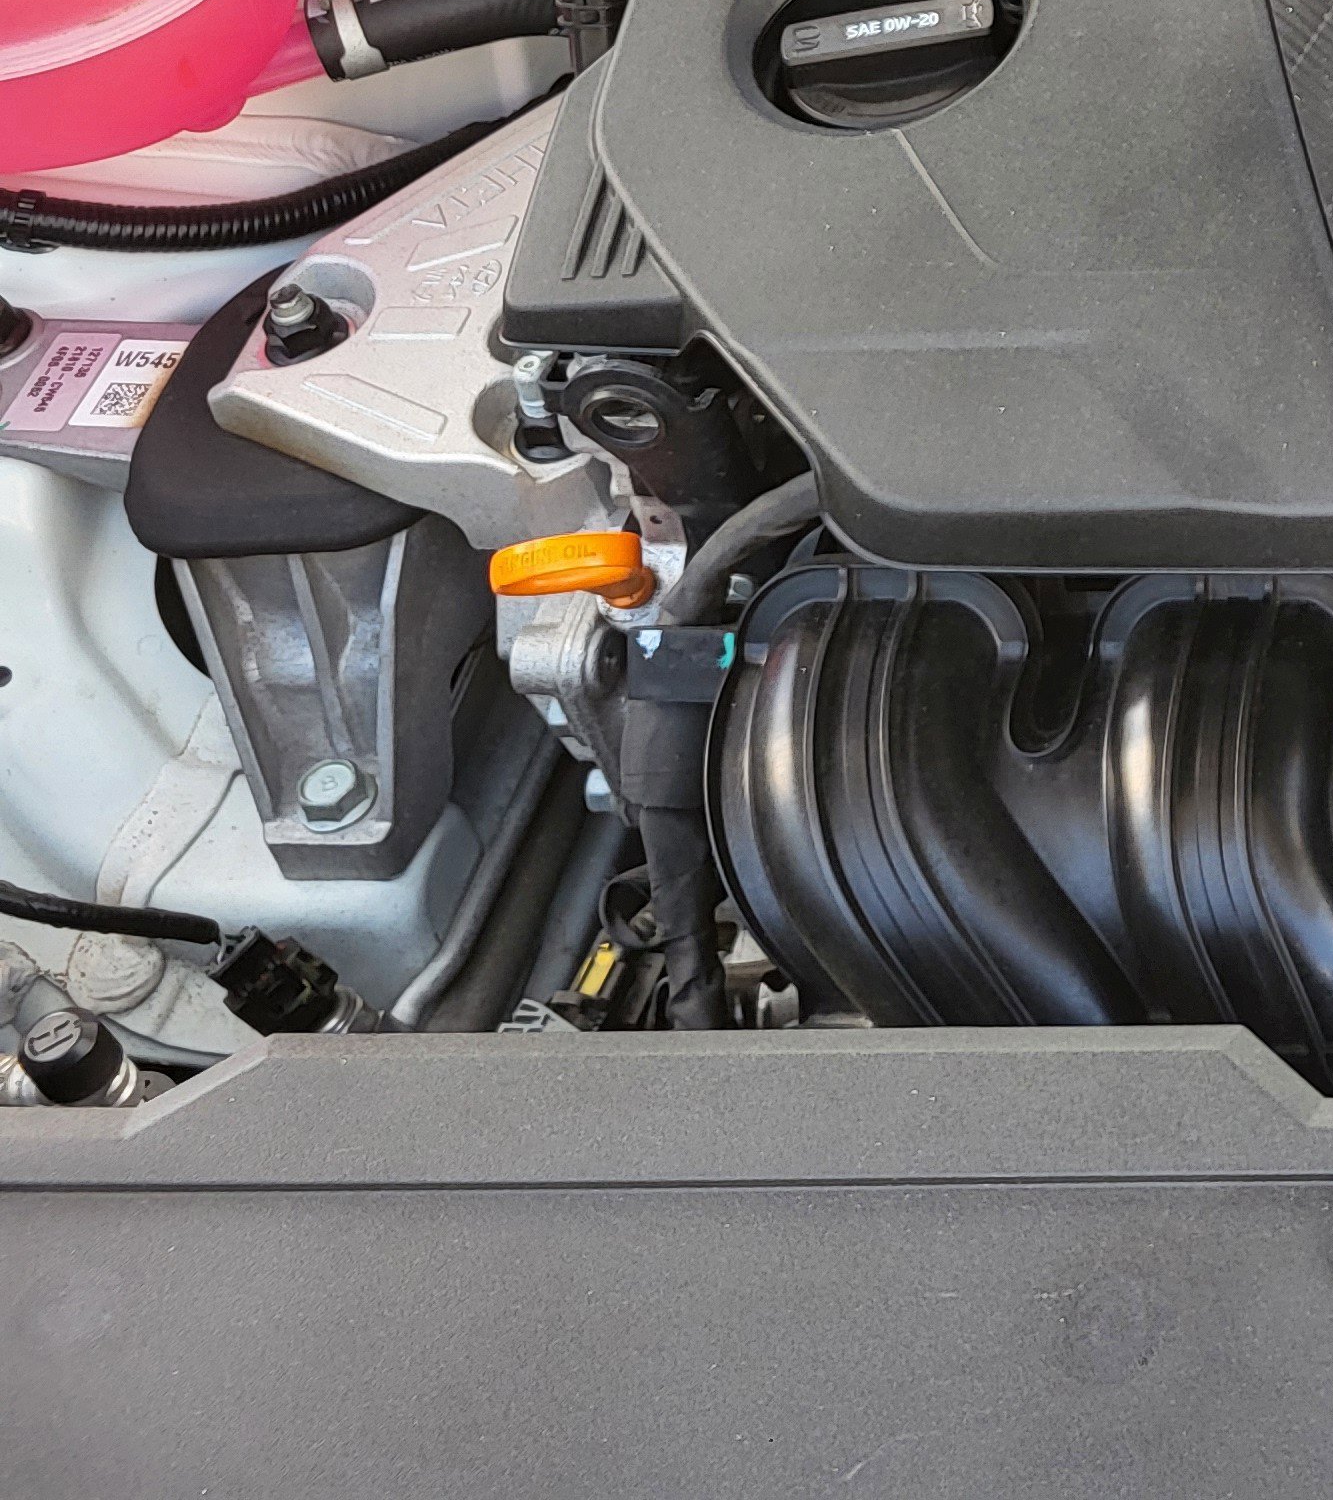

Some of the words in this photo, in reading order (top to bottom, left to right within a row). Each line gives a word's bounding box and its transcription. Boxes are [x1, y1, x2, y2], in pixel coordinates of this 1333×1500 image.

[845, 20, 882, 40] SAE
[883, 11, 940, 33] 0W-20
[115, 350, 181, 369] W545
